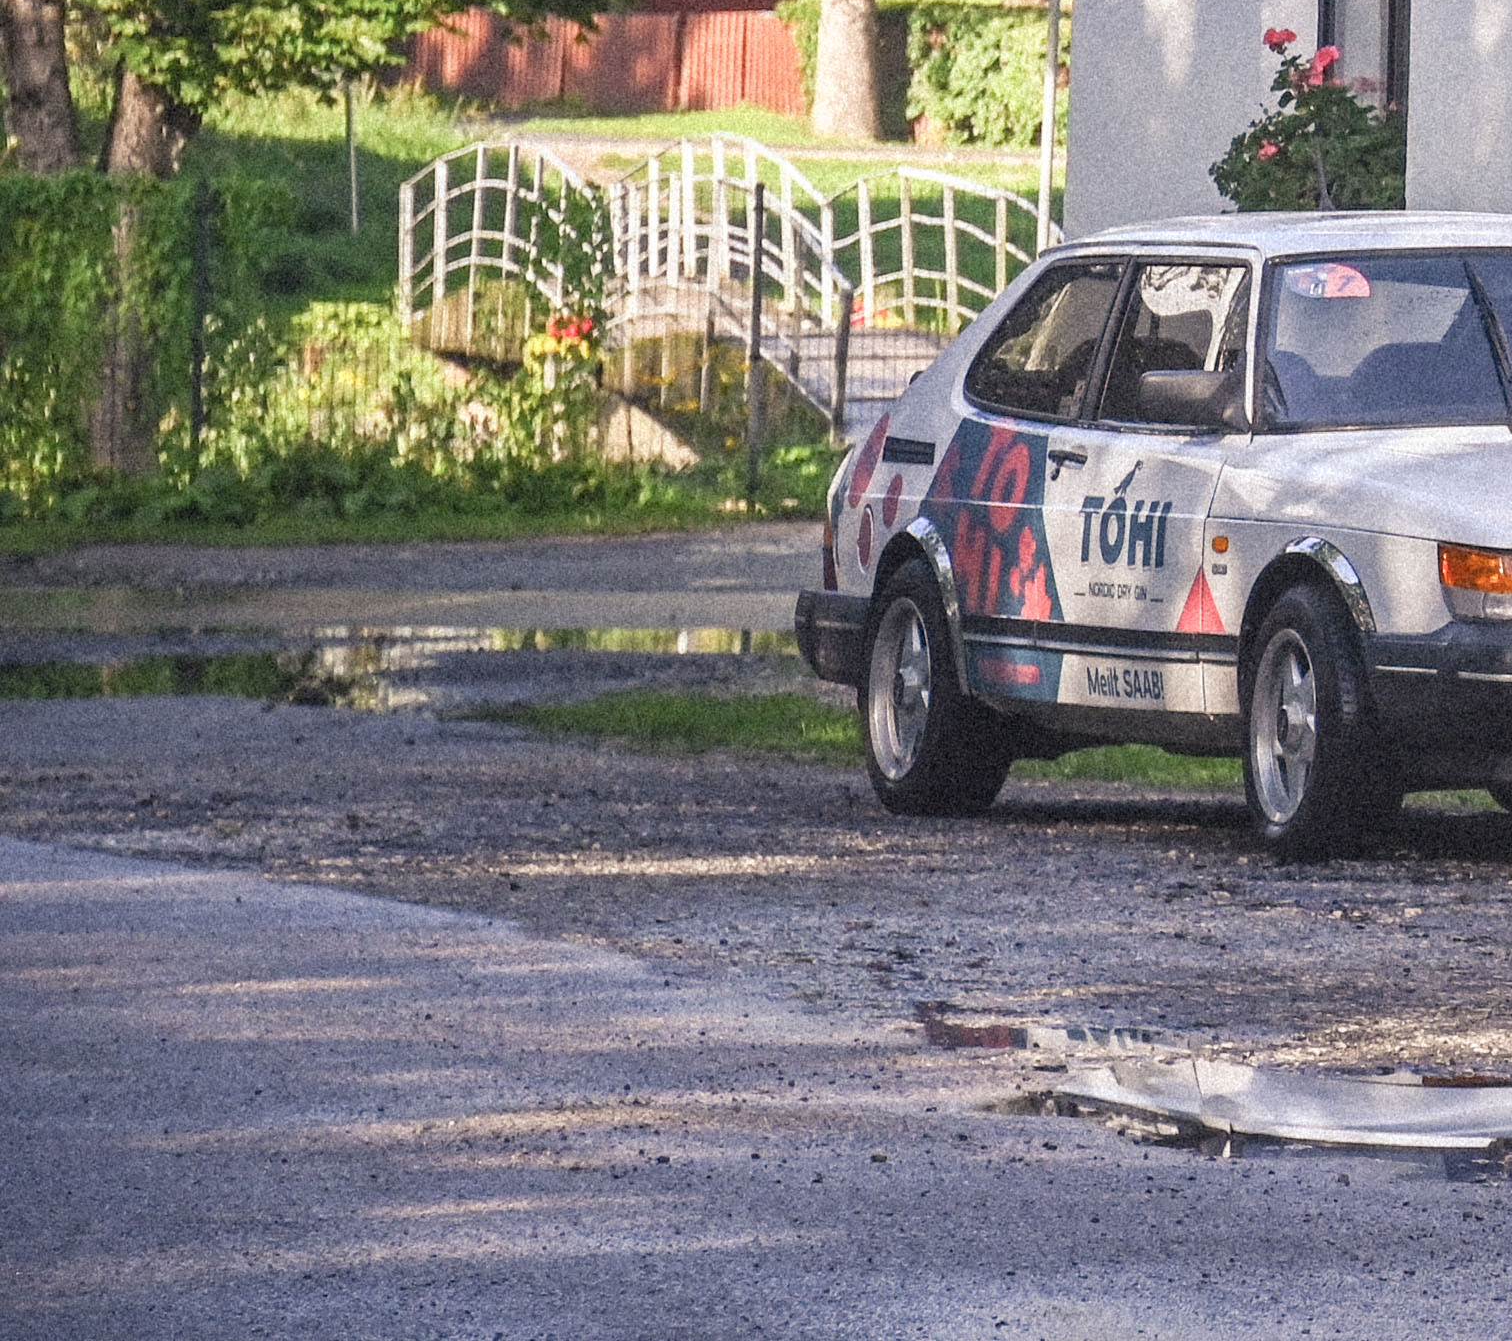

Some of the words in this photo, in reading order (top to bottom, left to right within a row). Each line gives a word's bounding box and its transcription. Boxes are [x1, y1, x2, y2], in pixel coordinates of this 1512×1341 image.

[1079, 495, 1174, 569] TOHI
[1088, 581, 1115, 598] NORDIC
[1117, 583, 1132, 599] DRY
[1134, 585, 1148, 601] GIN
[1086, 667, 1119, 697] Meilt
[1123, 669, 1165, 700] SAAB!
